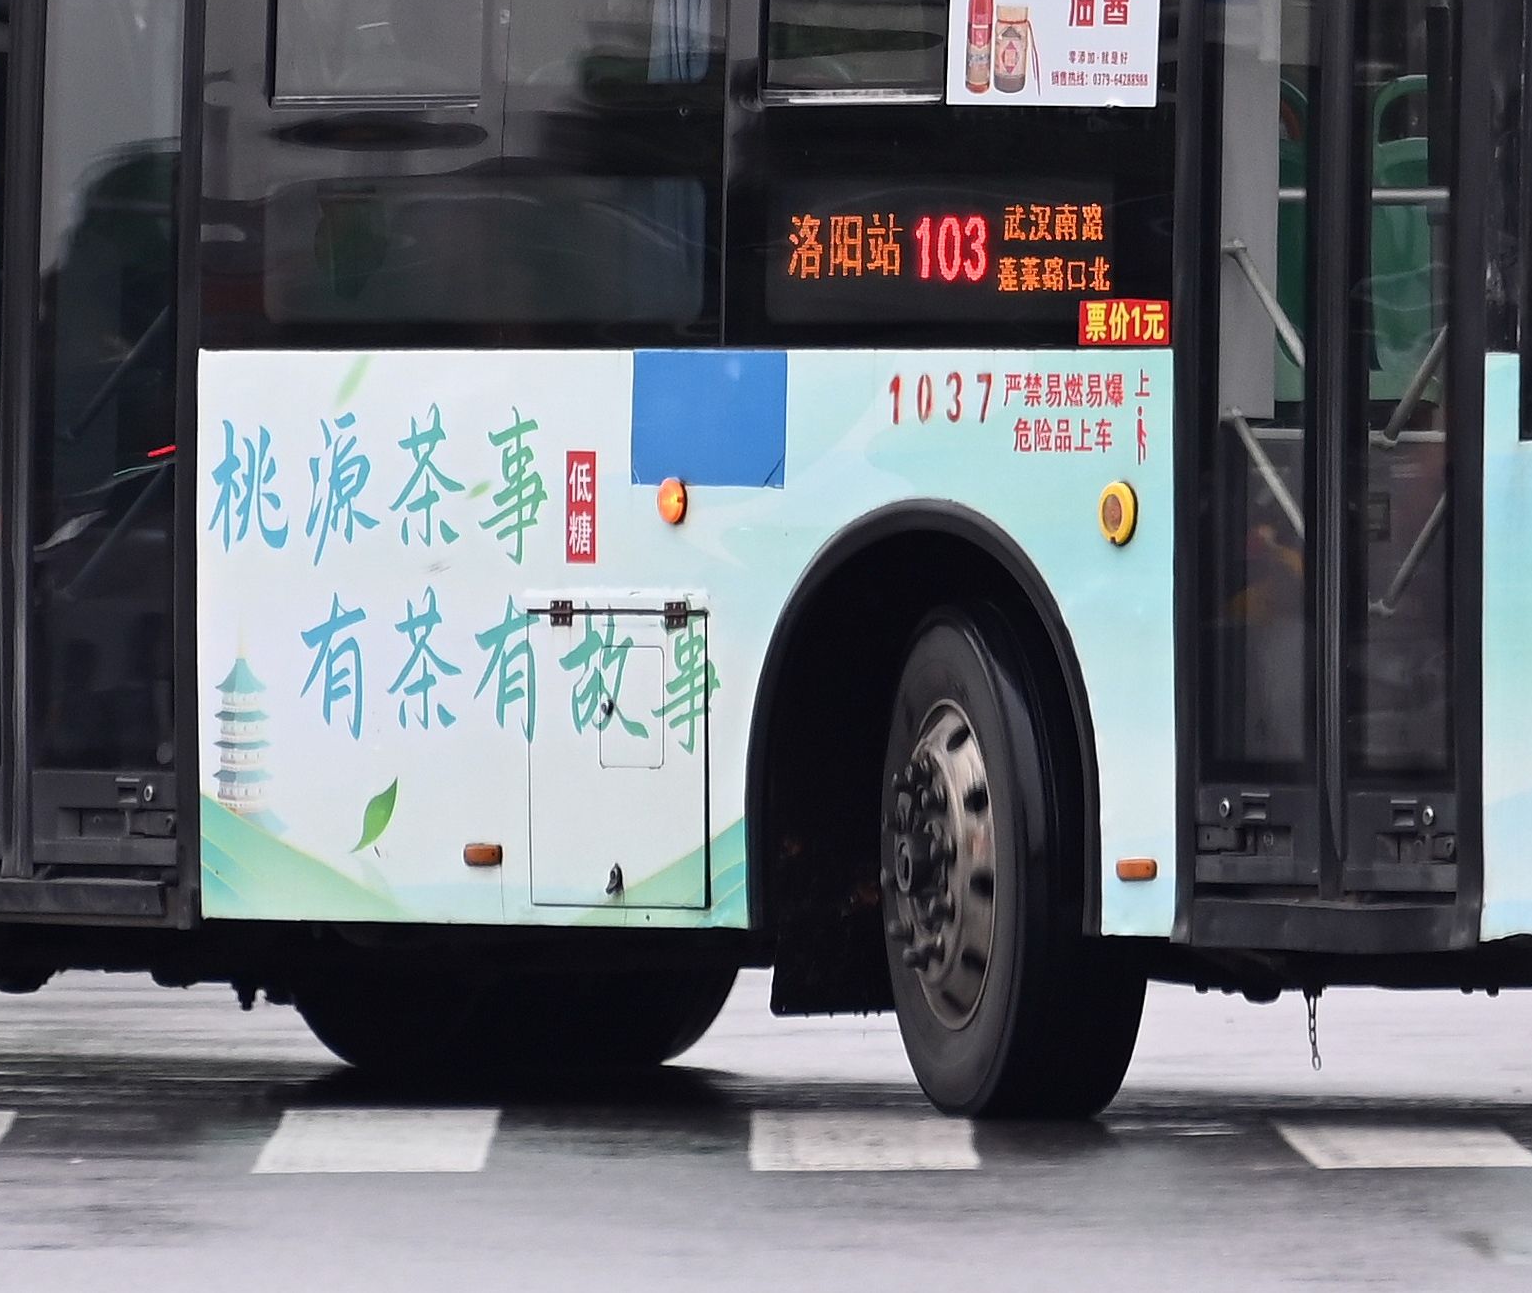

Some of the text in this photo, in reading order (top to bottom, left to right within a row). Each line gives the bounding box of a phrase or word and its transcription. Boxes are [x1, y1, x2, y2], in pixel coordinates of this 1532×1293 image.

[1003, 203, 1104, 241] 武汉南路
[788, 214, 987, 281] 洛阳站 103
[1084, 301, 1165, 341] 票价1元
[888, 372, 993, 425] 1037
[1003, 372, 1124, 408] 严禁易燃易爆
[1134, 369, 1151, 398] 上
[1013, 418, 1113, 453] 危险品上车
[208, 402, 548, 566] 桃源茶事
[568, 461, 593, 556] 低糖
[299, 586, 722, 755] 有茶有故事
